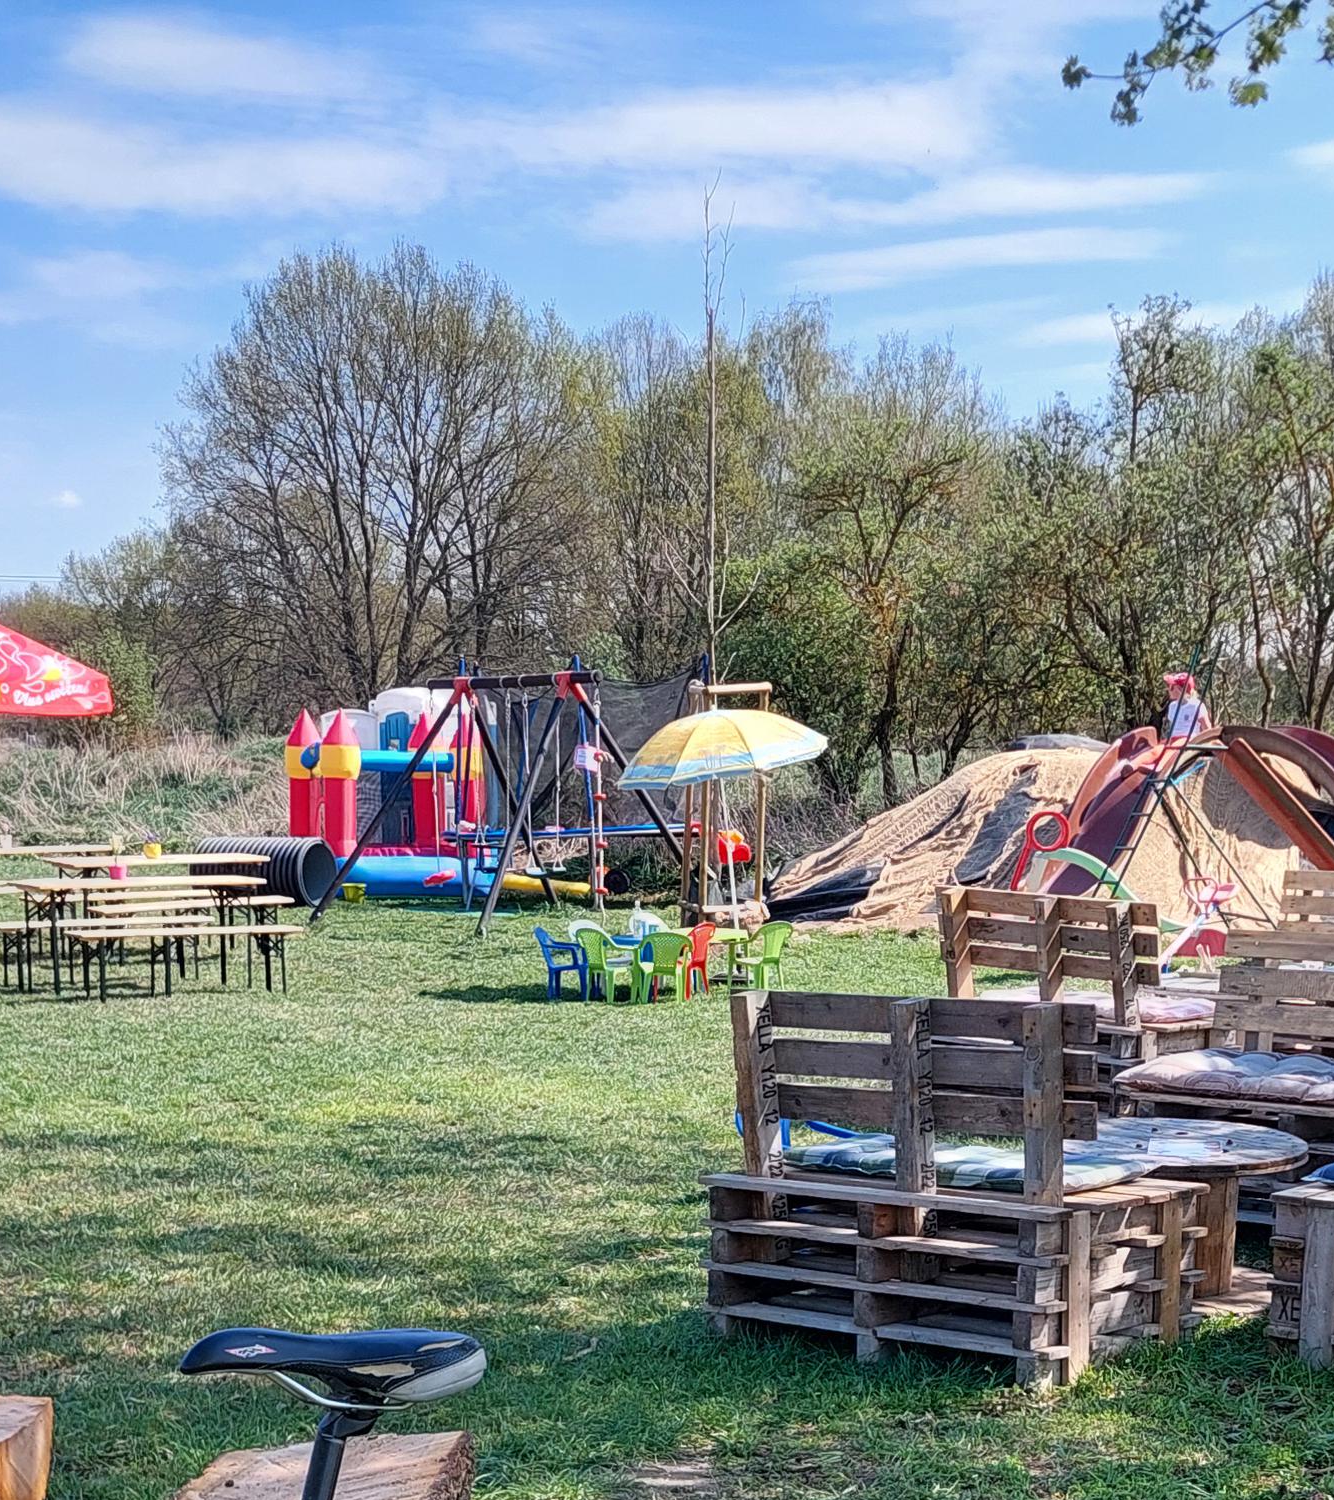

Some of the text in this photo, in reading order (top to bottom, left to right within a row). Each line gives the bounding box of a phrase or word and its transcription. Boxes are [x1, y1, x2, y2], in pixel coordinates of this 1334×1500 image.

[755, 1003, 773, 1054] XELLA
[915, 1008, 931, 1061] XELLA
[762, 1064, 777, 1100] Y120
[918, 1071, 933, 1107] Y120
